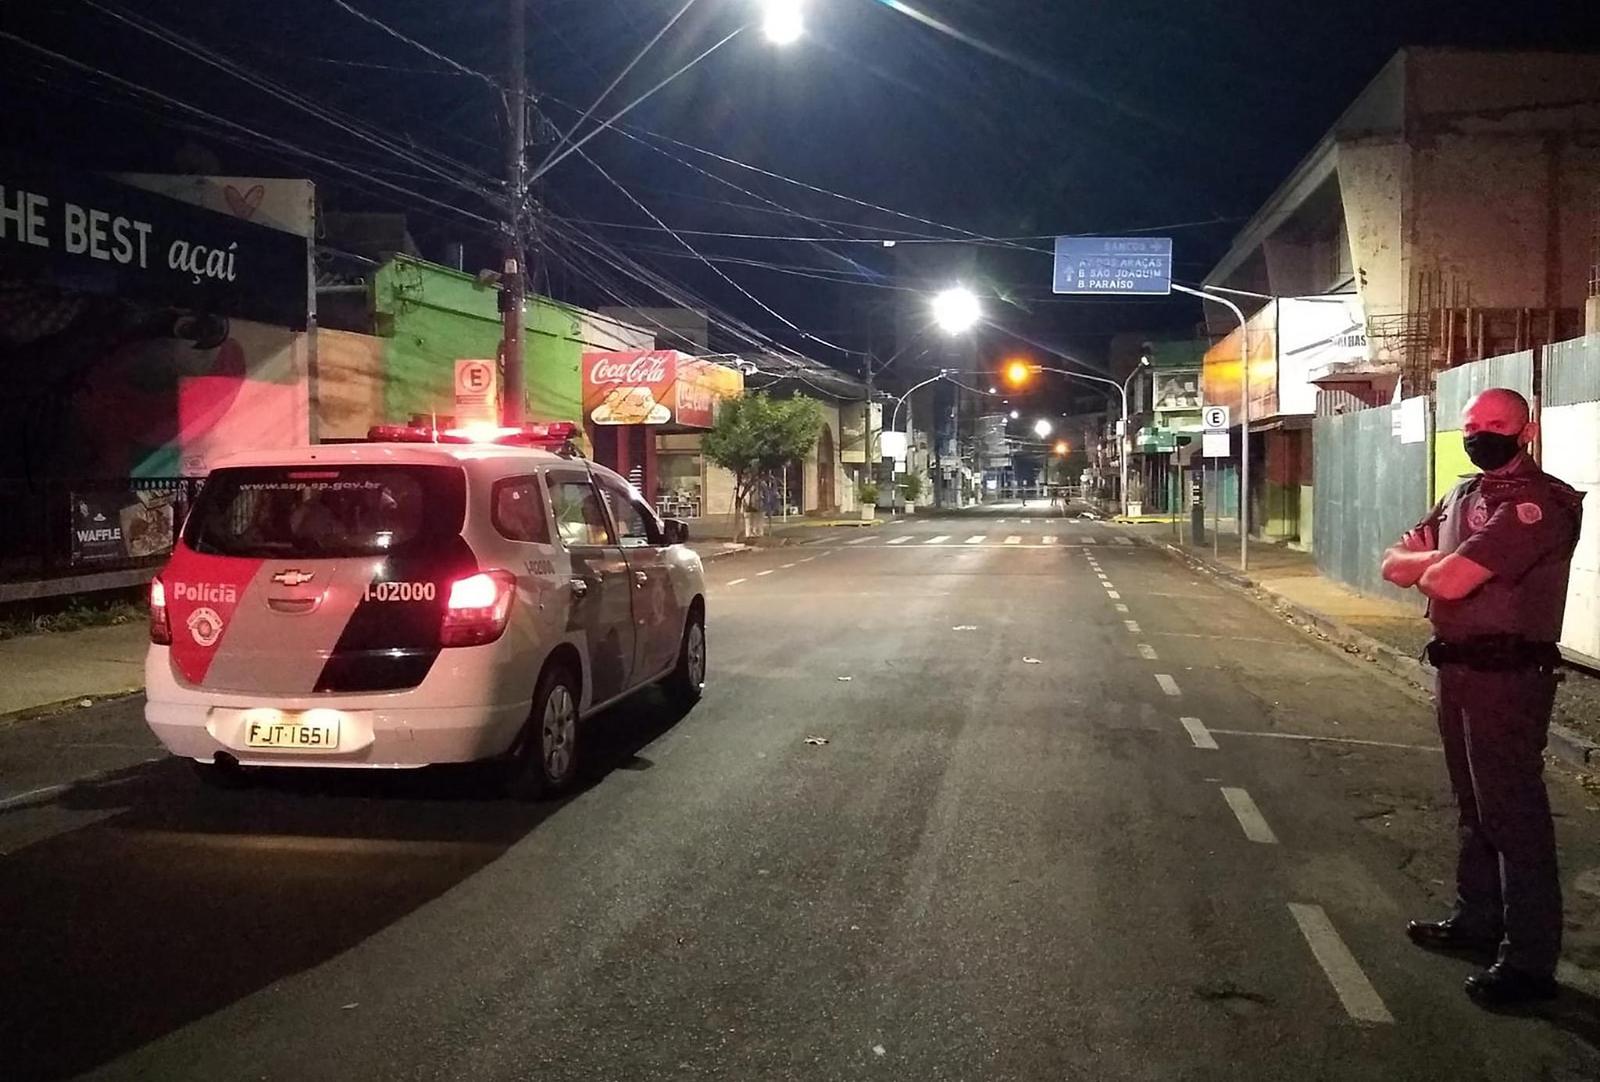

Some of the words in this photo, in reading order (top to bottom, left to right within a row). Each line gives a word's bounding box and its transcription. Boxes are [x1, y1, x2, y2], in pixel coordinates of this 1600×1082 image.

[65, 202, 152, 268] BEST
[168, 241, 238, 284] açaí
[1115, 268, 1161, 278] JOAQUIM
[1089, 276, 1133, 289] PARAÍSO
[471, 369, 482, 387] E
[1212, 412, 1220, 424] E
[77, 527, 121, 542] WAFFLE
[173, 582, 236, 603] Polícia
